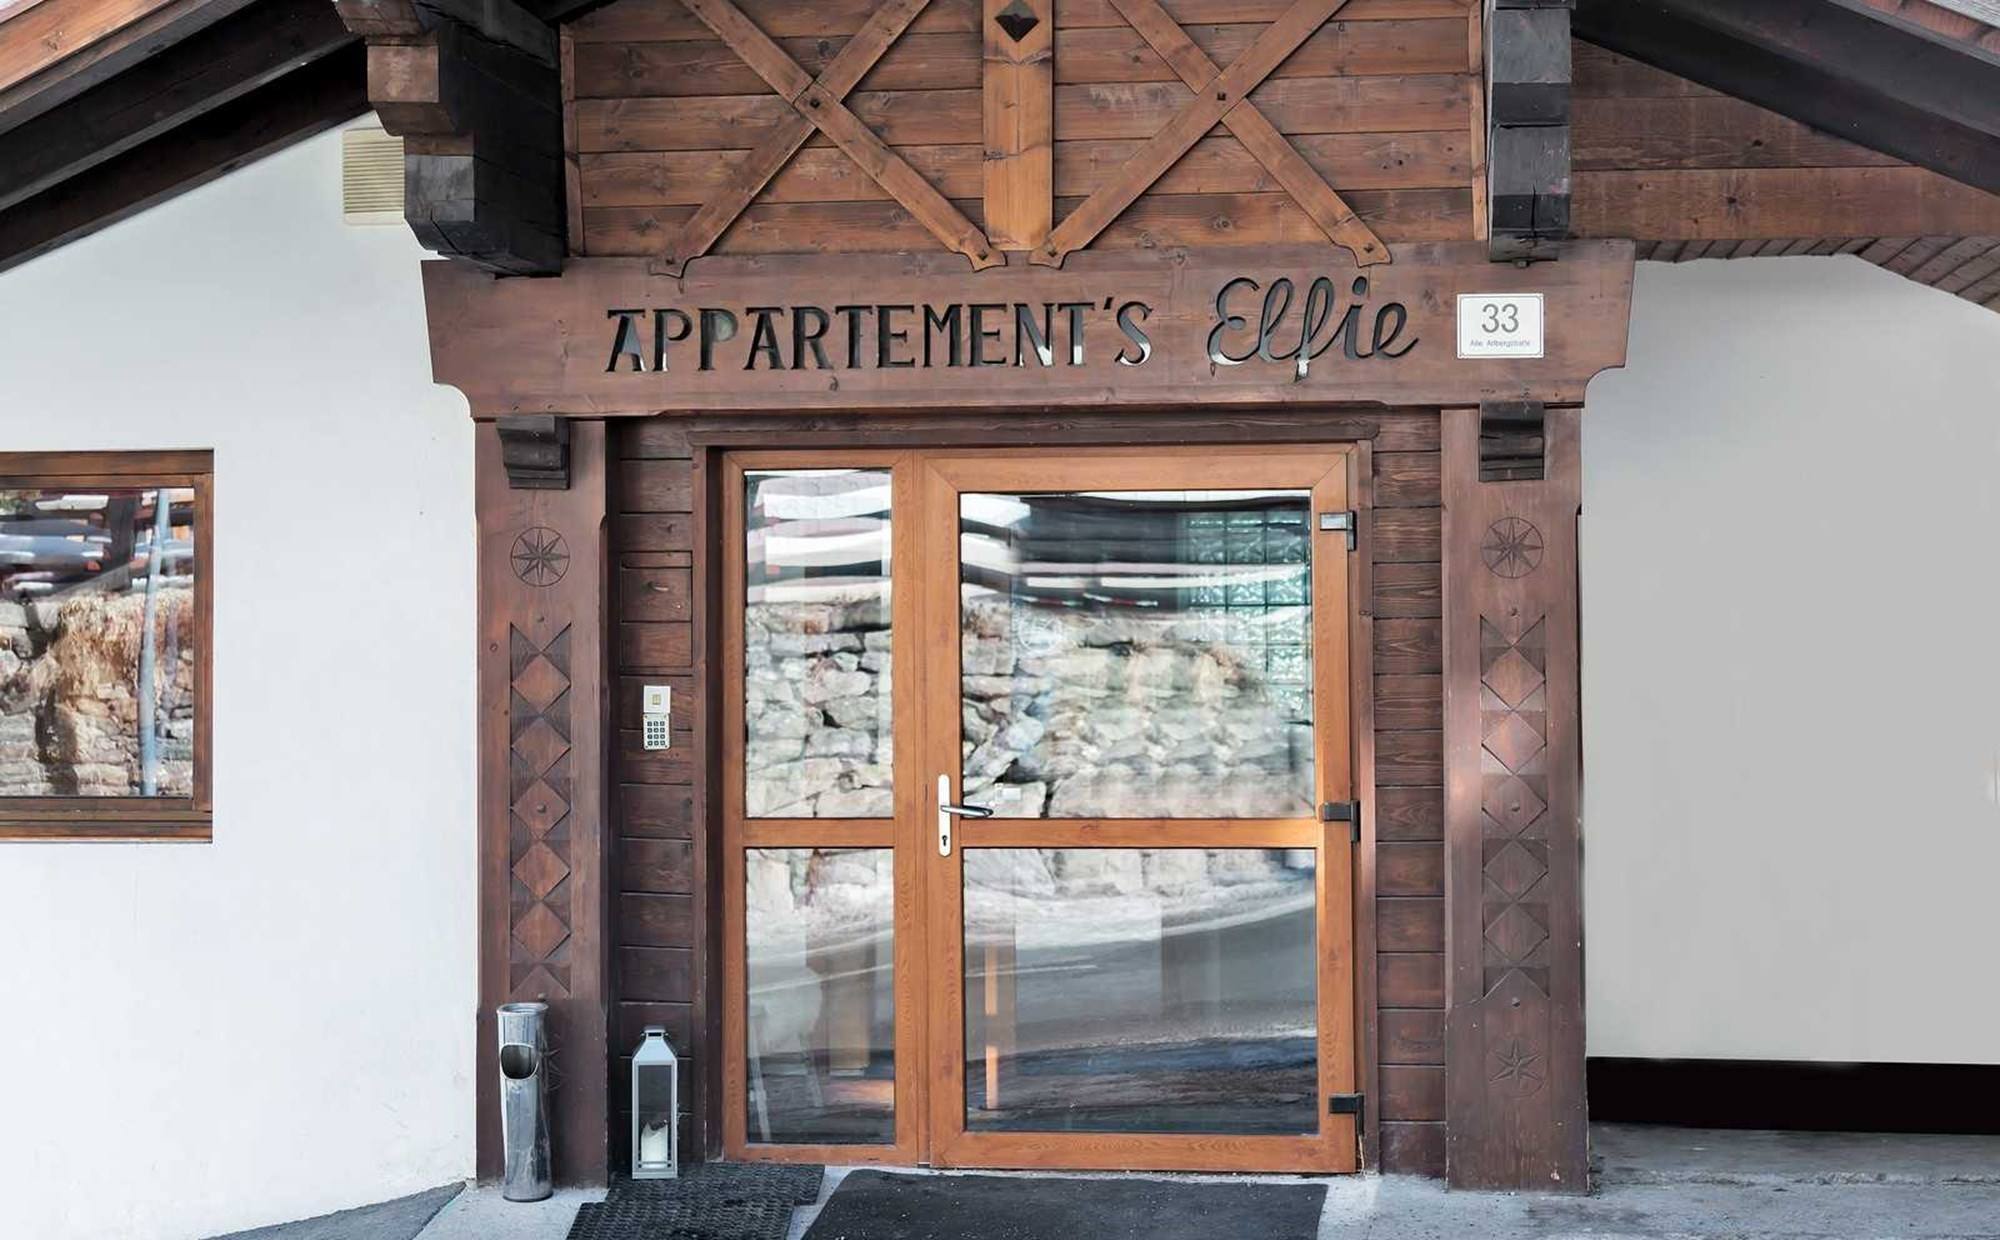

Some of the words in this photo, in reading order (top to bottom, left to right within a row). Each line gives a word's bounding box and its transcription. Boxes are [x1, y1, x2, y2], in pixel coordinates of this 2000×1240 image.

[606, 297, 1154, 373] APPARTEMENT'S
[1207, 276, 1420, 382] Elfie
[1481, 303, 1520, 333] 33
